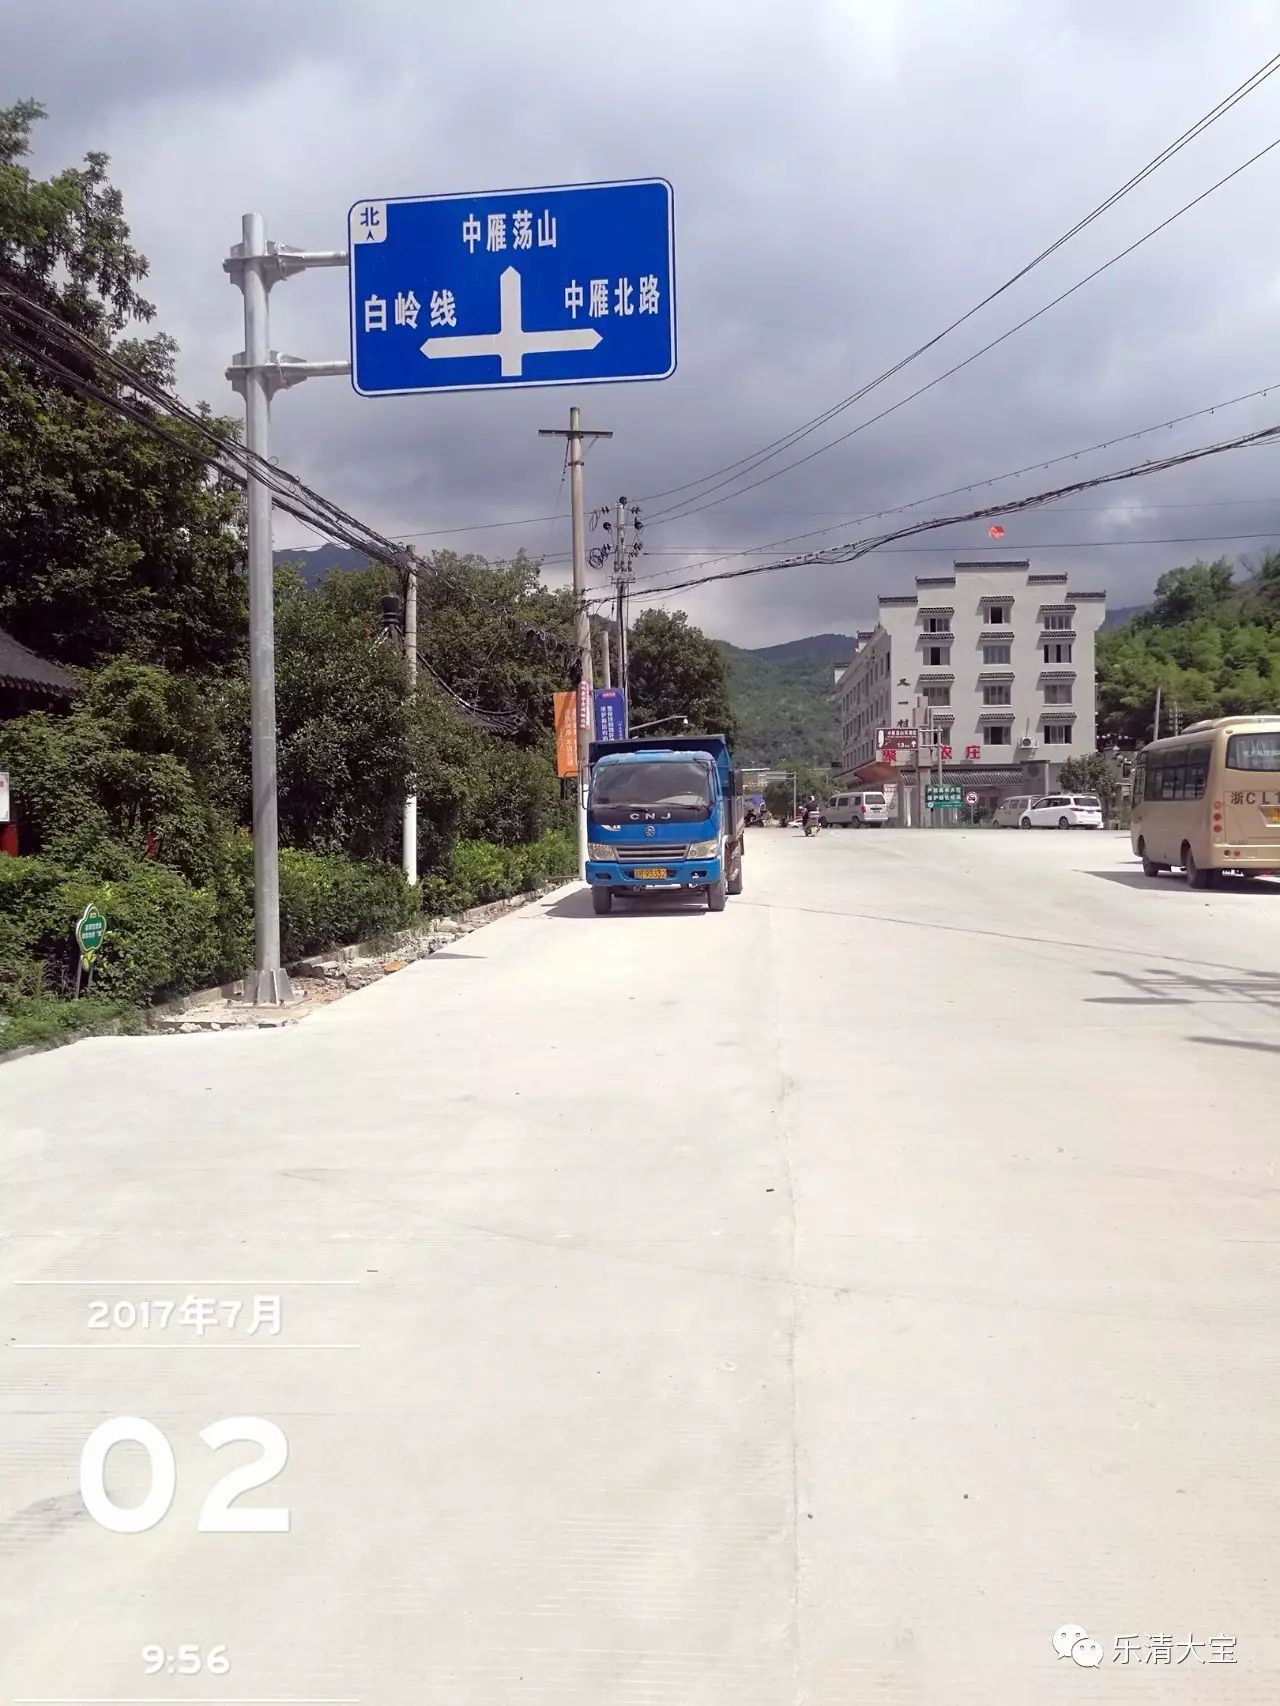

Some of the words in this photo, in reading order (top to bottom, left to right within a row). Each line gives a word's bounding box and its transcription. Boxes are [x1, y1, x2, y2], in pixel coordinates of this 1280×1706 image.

[360, 207, 380, 227] 北
[462, 209, 557, 254] 中雁荡山
[364, 289, 458, 333] 白岭线
[564, 274, 660, 319] 中雁北路
[630, 812, 671, 820] CNJ
